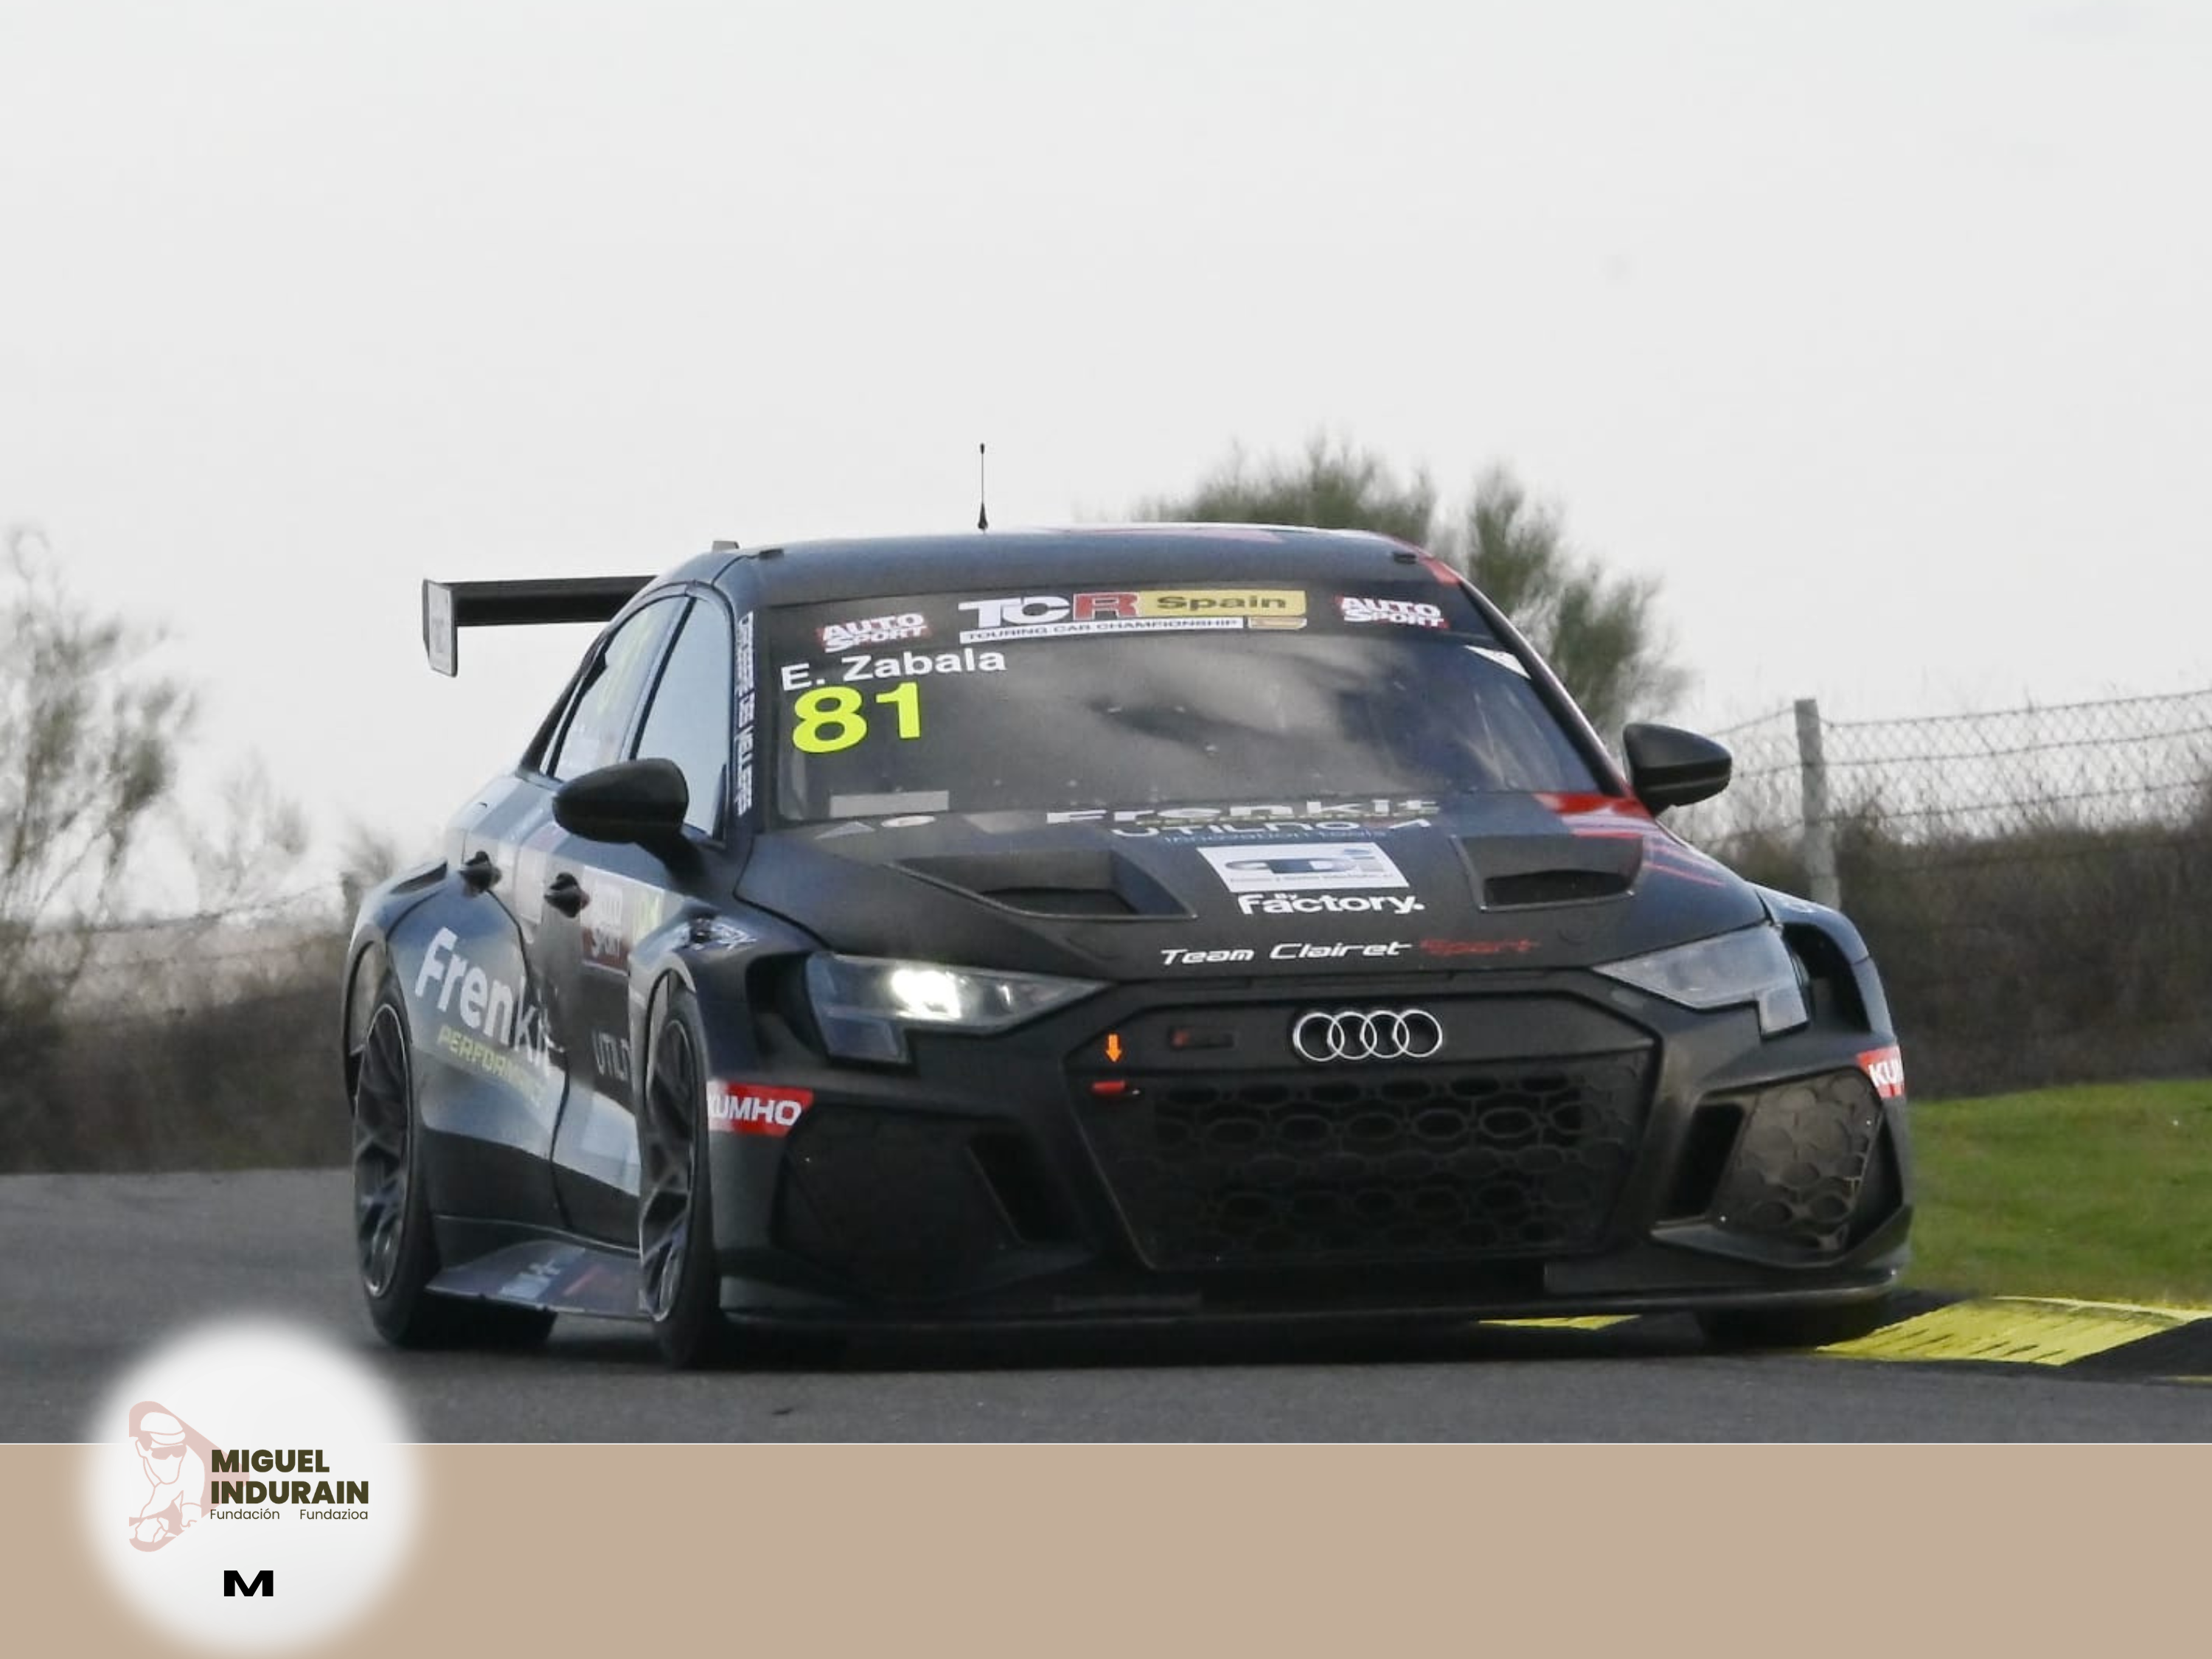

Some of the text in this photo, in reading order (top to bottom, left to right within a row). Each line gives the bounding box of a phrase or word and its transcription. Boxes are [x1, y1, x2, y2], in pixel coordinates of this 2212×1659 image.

[959, 591, 1286, 629] TCR Spain
[1342, 597, 1441, 618] AUTO
[822, 613, 926, 641] AUTO
[824, 625, 928, 653] SPORT
[968, 629, 1048, 640] TOURING
[1053, 625, 1091, 634] CAR
[1096, 619, 1239, 630] CHAMPIONSHIP
[781, 647, 1007, 691] E. Zabala
[793, 682, 921, 754] 81
[1046, 799, 1440, 824] Frenkit
[1238, 894, 1425, 914] Factory.
[1161, 949, 1254, 966] Team
[1269, 941, 1413, 960] Clairet
